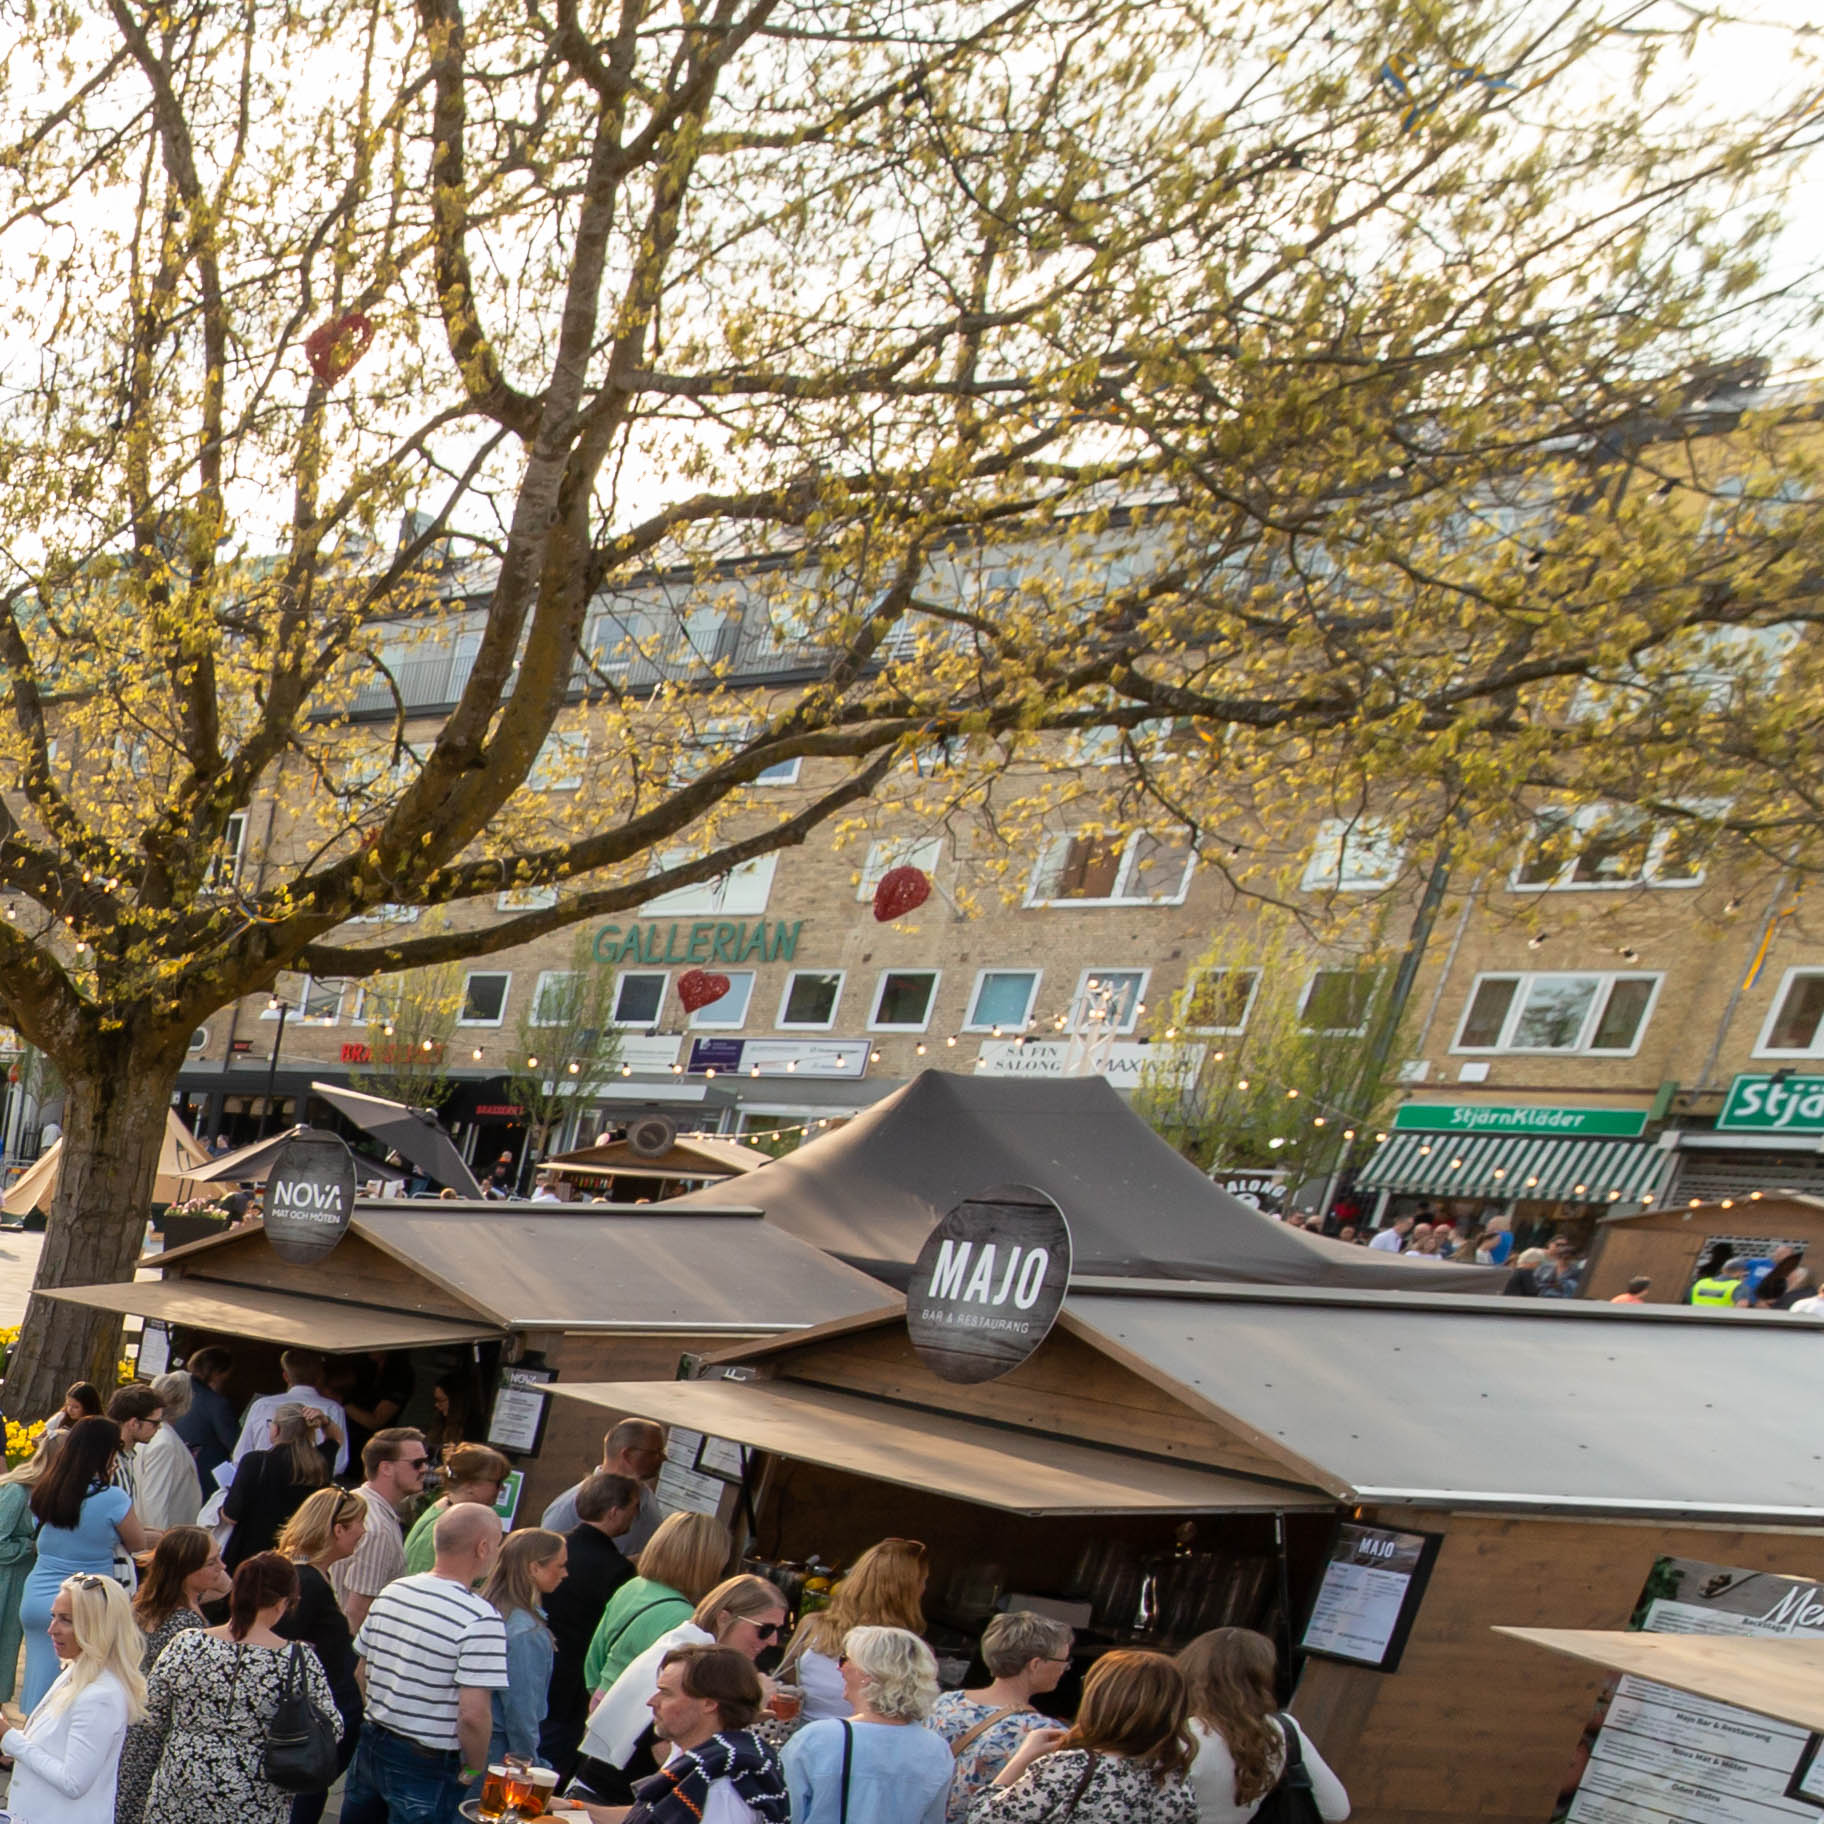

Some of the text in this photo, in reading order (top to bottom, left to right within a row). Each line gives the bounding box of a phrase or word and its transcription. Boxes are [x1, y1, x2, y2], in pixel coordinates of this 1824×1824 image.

[592, 919, 802, 964] GALLERIAN
[994, 1060, 1062, 1072] SALONG
[1450, 1106, 1586, 1129] StjärnKläder
[273, 1180, 343, 1211] NOVA
[1219, 1179, 1288, 1198] ALONG
[272, 1208, 289, 1218] MAT
[290, 1210, 309, 1220] OCH
[928, 1239, 1049, 1311] MAJO
[921, 1308, 944, 1324] BAR
[957, 1314, 1030, 1334] RESTAURANG
[1358, 1537, 1396, 1559] MAJO
